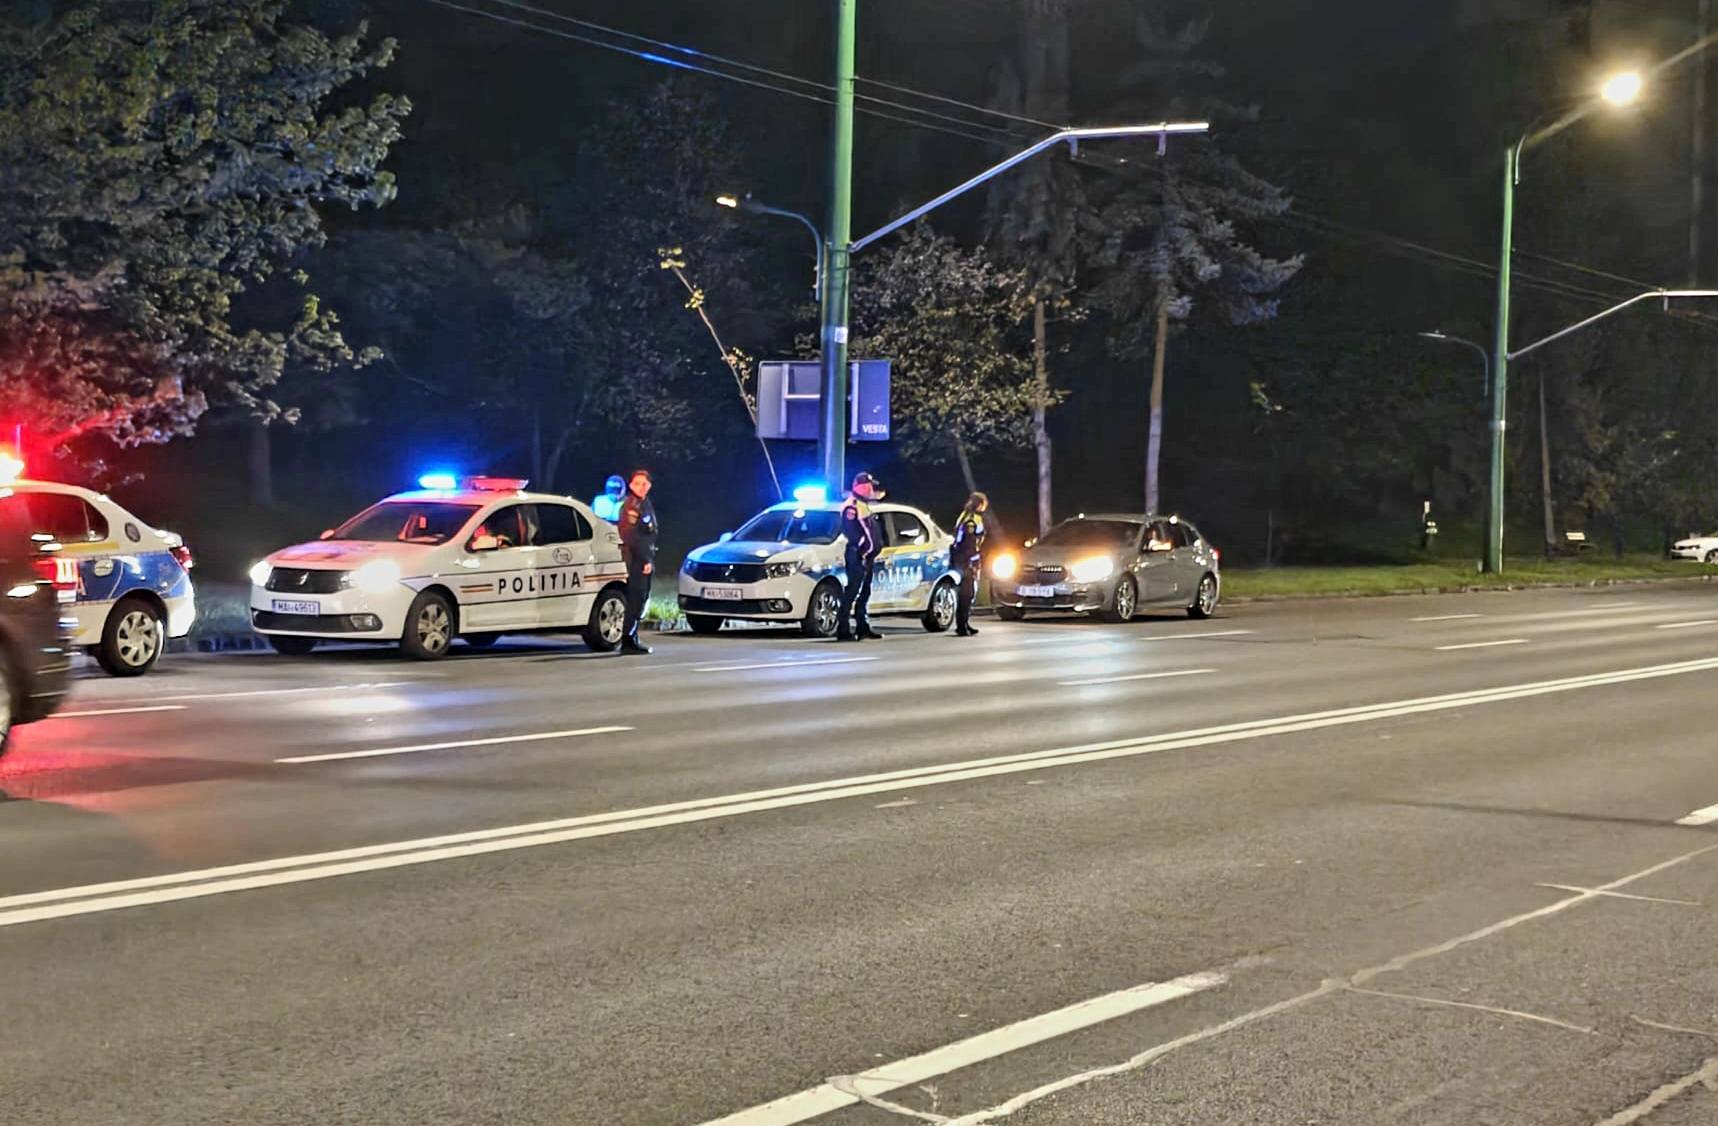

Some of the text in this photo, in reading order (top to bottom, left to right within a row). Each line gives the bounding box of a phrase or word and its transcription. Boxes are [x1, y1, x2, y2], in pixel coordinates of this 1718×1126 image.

[862, 424, 888, 434] VESTA
[498, 571, 581, 595] POLITIA
[872, 565, 923, 584] OLITIA
